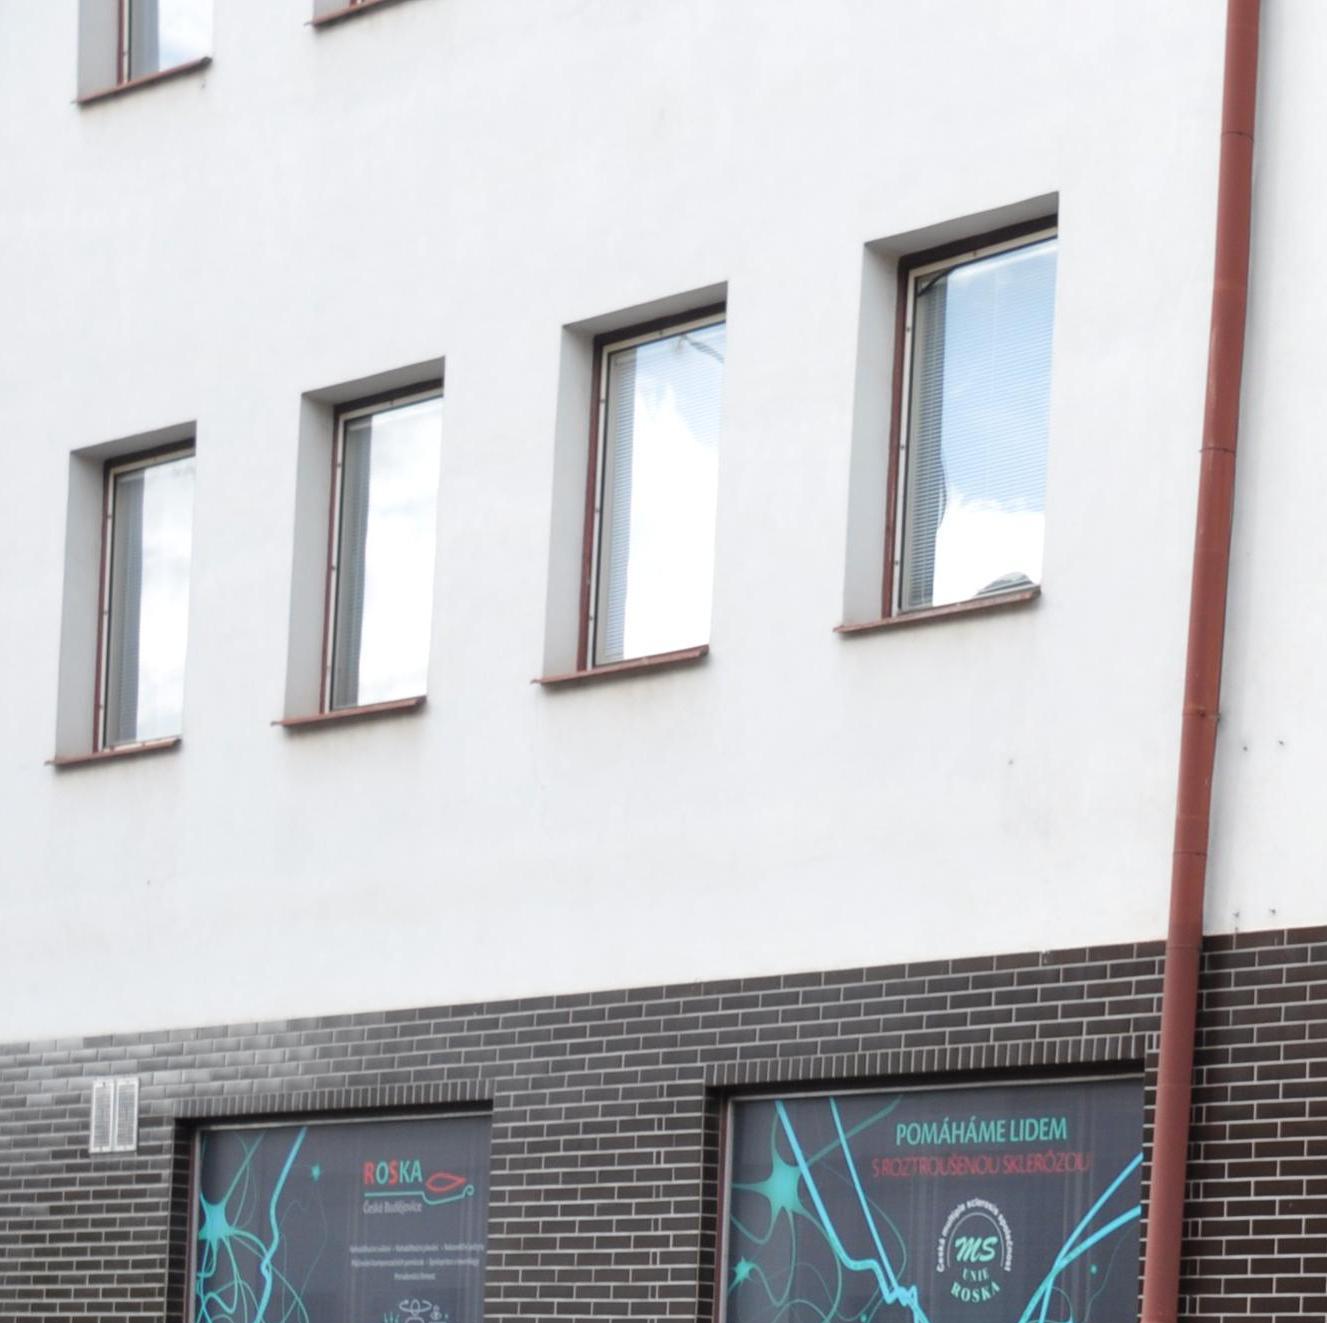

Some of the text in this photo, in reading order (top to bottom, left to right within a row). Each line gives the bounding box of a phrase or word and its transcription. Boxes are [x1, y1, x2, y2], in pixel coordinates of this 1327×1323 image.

[896, 1116, 1067, 1145] POMÁHÁME LIDEM
[363, 1159, 423, 1184] ROSKA
[955, 1236, 998, 1262] MS
[951, 1281, 1000, 1303] ROSKA
